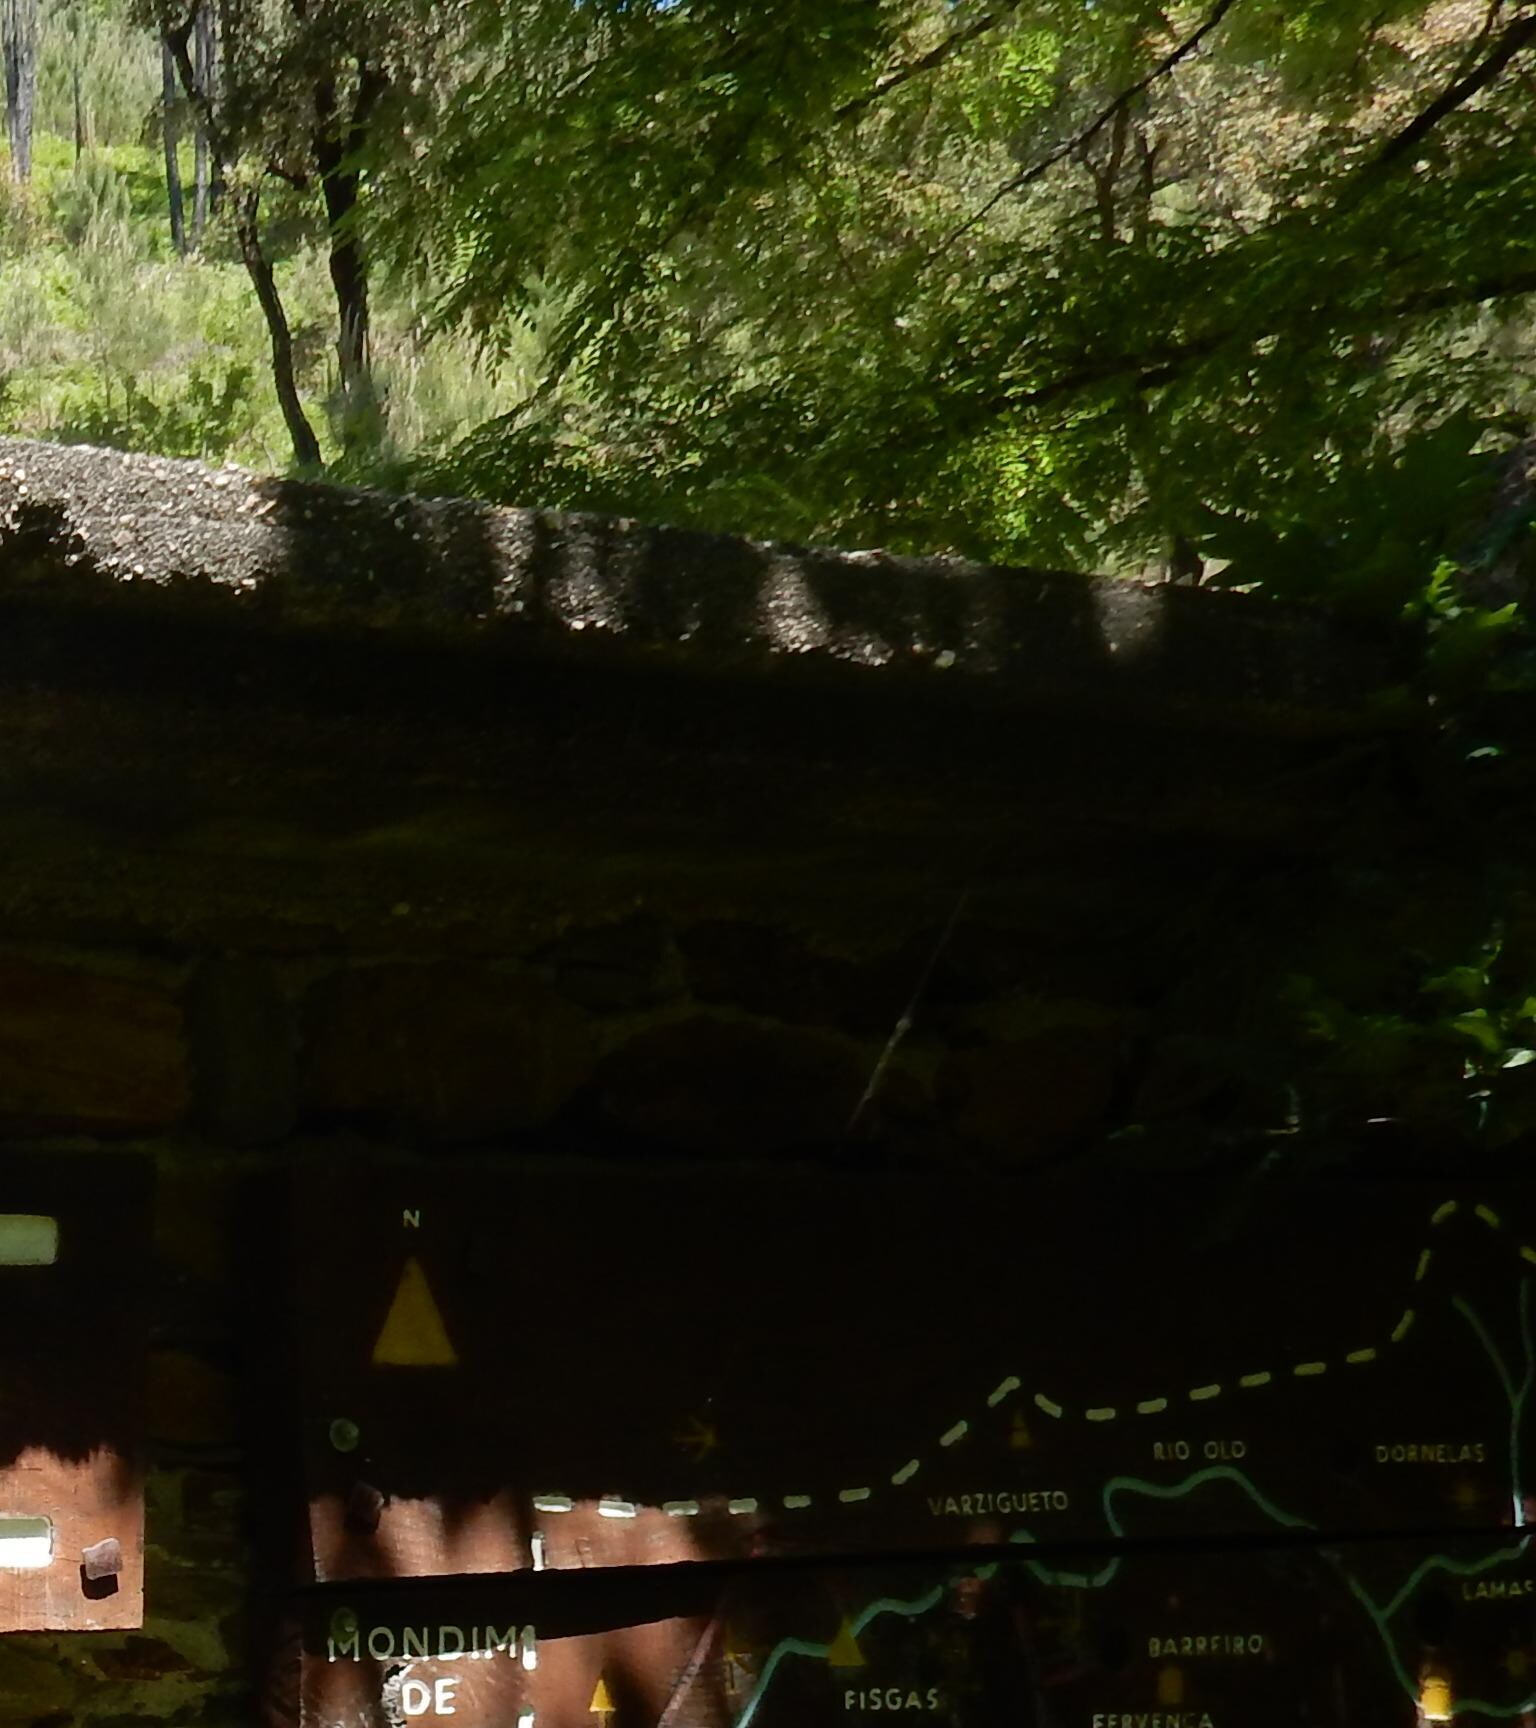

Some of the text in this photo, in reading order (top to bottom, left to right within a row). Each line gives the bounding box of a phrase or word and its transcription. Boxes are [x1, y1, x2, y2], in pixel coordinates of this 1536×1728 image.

[402, 1209, 420, 1228] N
[1153, 1441, 1190, 1461] RIO
[1375, 1442, 1486, 1465] DORNELAS
[928, 1490, 1069, 1517] VARZIGUETO
[402, 1677, 460, 1715] DE
[844, 1687, 938, 1712] FISGAS
